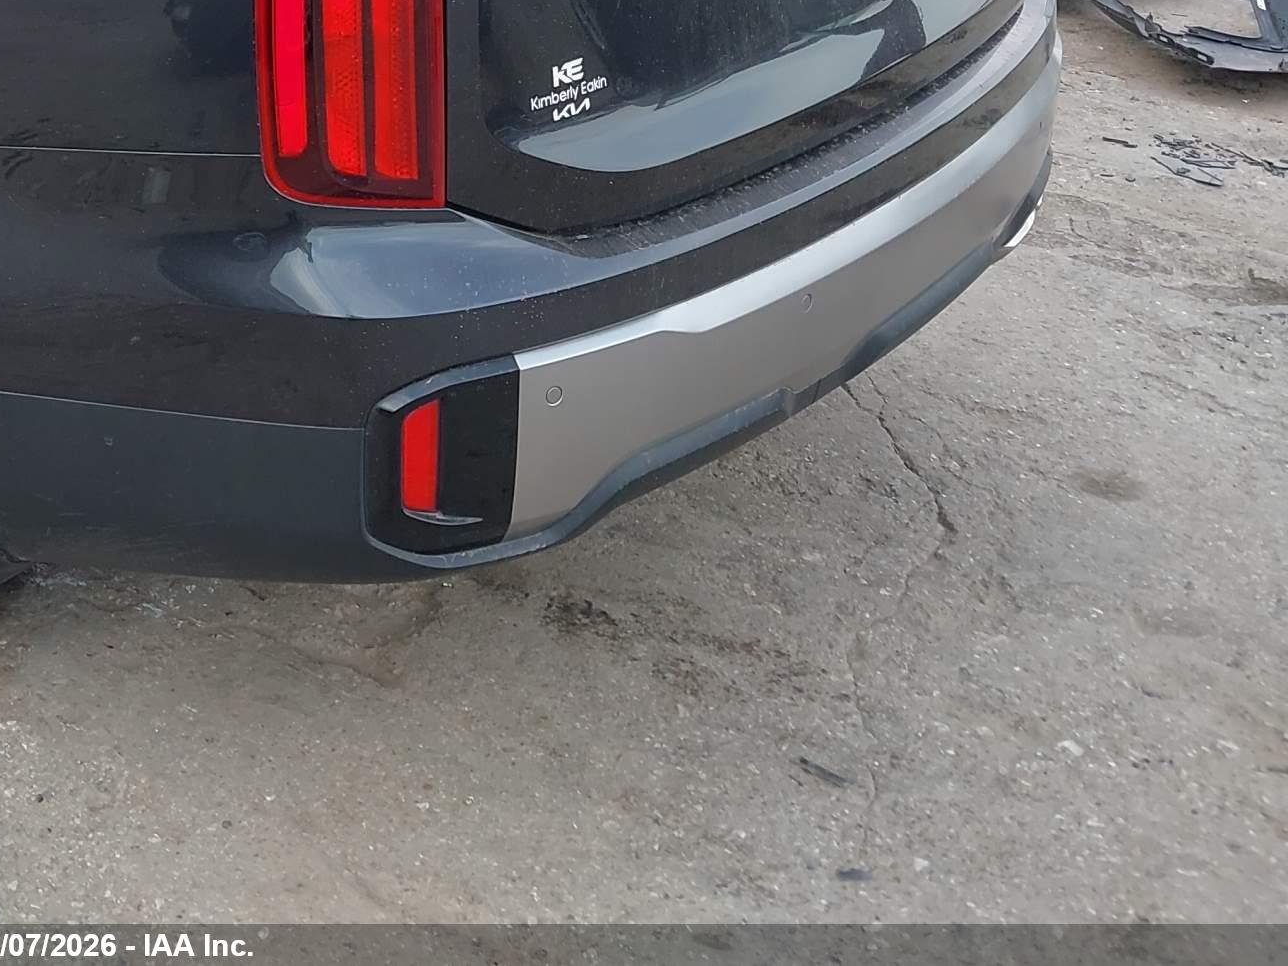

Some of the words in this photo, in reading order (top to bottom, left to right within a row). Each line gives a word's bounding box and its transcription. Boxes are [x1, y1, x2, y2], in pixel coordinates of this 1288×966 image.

[552, 57, 584, 88] KE
[530, 84, 579, 111] Kimberly
[580, 75, 608, 95] Eakin
[552, 97, 591, 122] KIA
